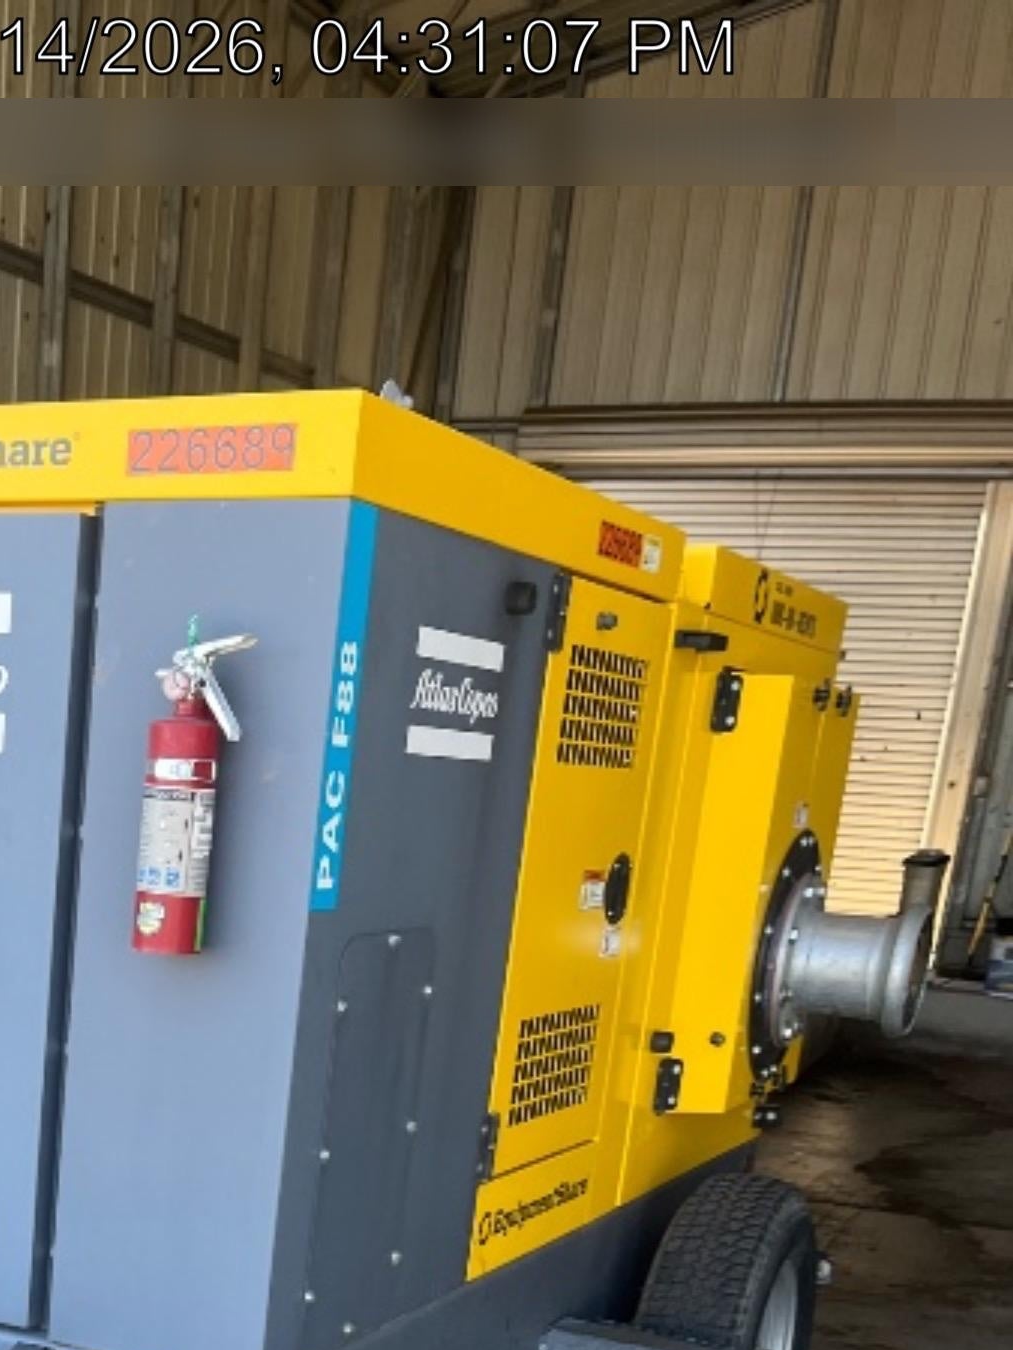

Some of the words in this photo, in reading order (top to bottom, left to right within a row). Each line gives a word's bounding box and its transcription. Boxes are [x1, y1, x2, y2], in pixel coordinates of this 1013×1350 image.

[131, 423, 294, 473] 226689
[316, 770, 346, 890] PAC
[331, 640, 358, 748] F88
